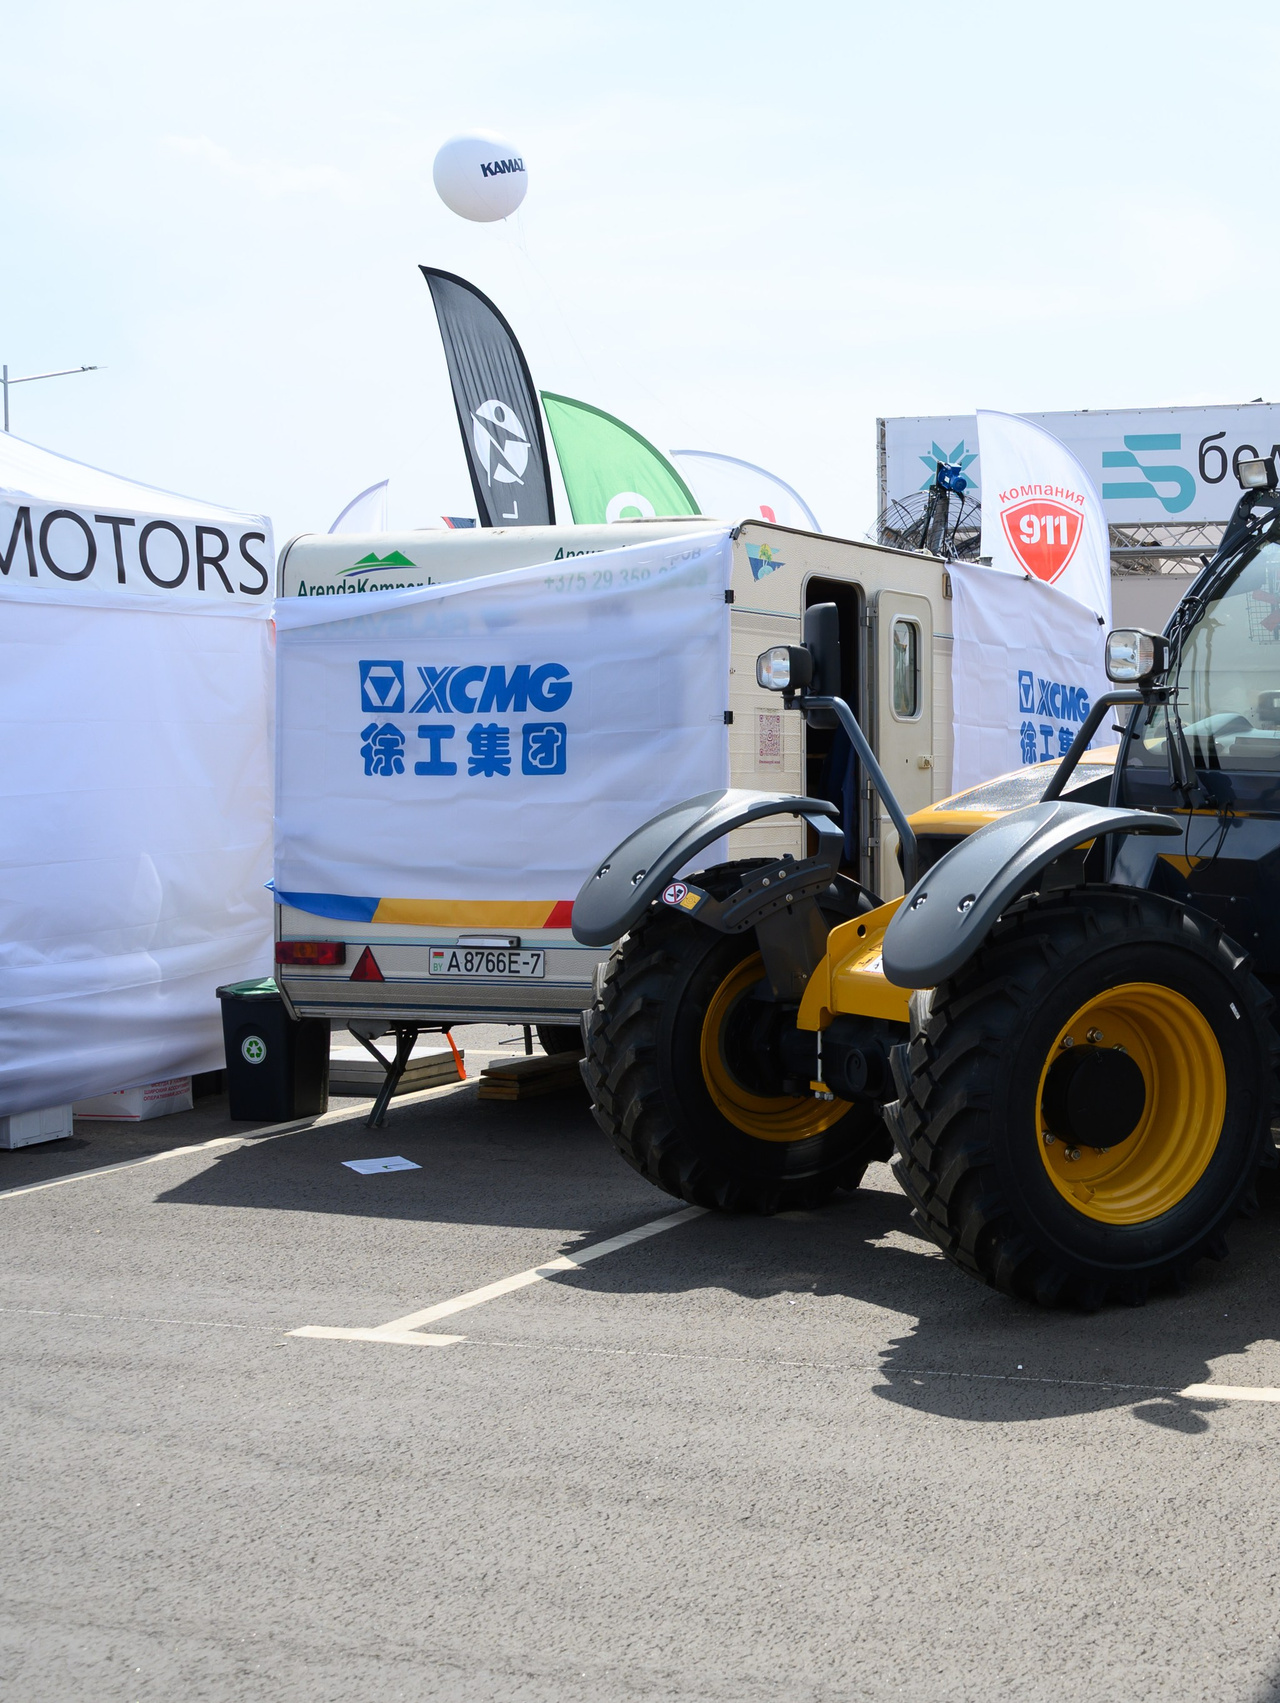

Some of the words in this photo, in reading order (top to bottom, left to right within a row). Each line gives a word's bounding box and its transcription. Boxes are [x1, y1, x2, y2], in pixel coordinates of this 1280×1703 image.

[480, 157, 525, 178] KAMAZ
[999, 484, 1085, 506] компания
[1019, 514, 1068, 545] 911
[408, 662, 573, 714] XCMG
[1036, 678, 1090, 723] XCMG
[360, 722, 567, 777] 徐工集团
[1020, 721, 1091, 764] 徐工集
[432, 962, 443, 972] BY
